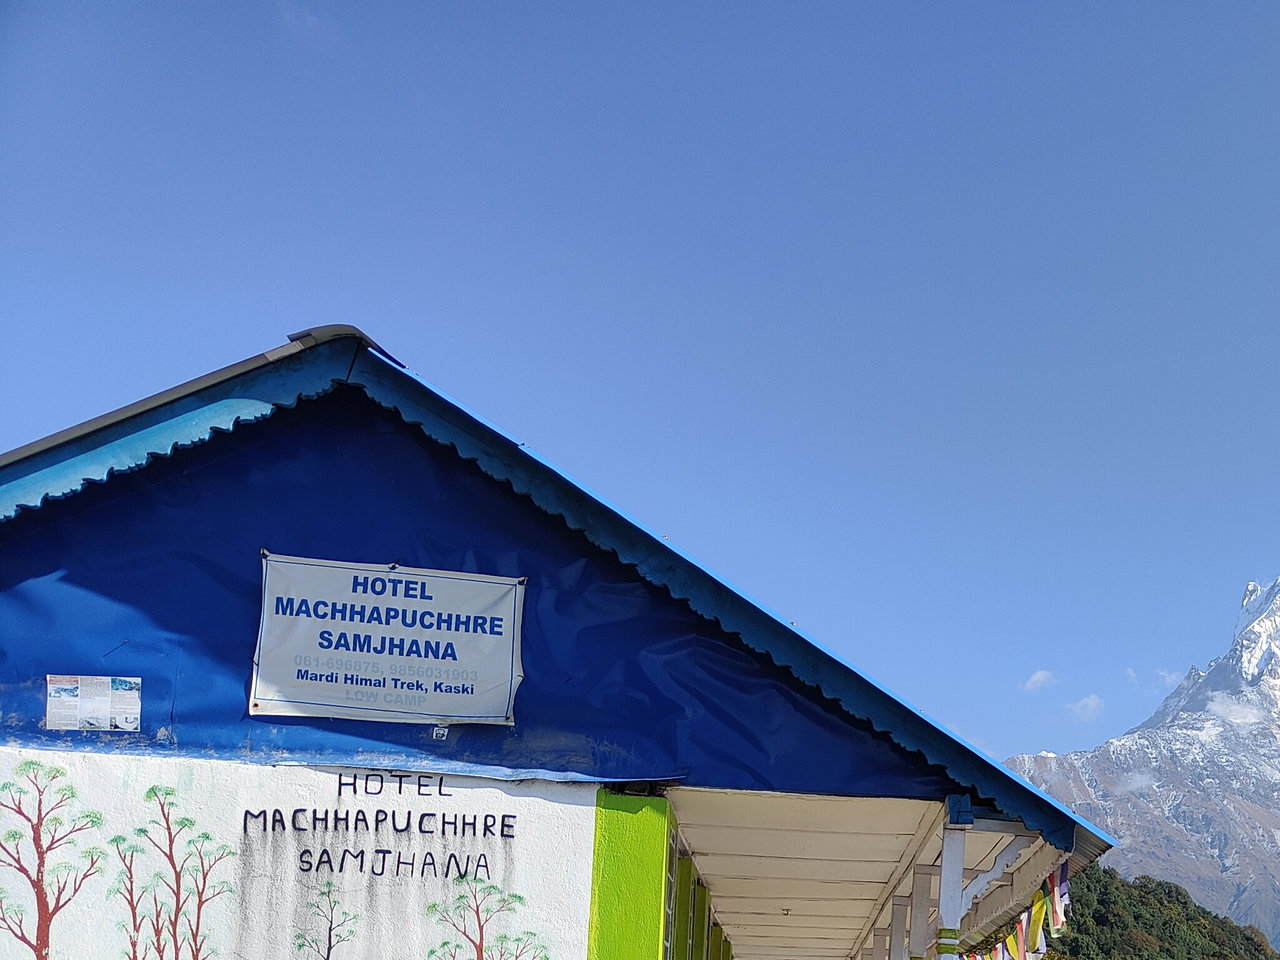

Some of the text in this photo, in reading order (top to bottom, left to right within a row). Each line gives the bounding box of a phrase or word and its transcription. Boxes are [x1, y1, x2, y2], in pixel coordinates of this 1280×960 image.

[352, 575, 433, 600] HOTEL
[275, 597, 504, 636] MACHHAPUCHHRE
[318, 630, 458, 661] SAMJHANA
[296, 669, 474, 695] Mardi Himal Trek, Kaski
[345, 689, 426, 706] LOW CAMP
[338, 772, 453, 797] HOTEL
[243, 808, 517, 839] MACHHAPUCHHRE
[299, 849, 491, 880] SAMJHANA
